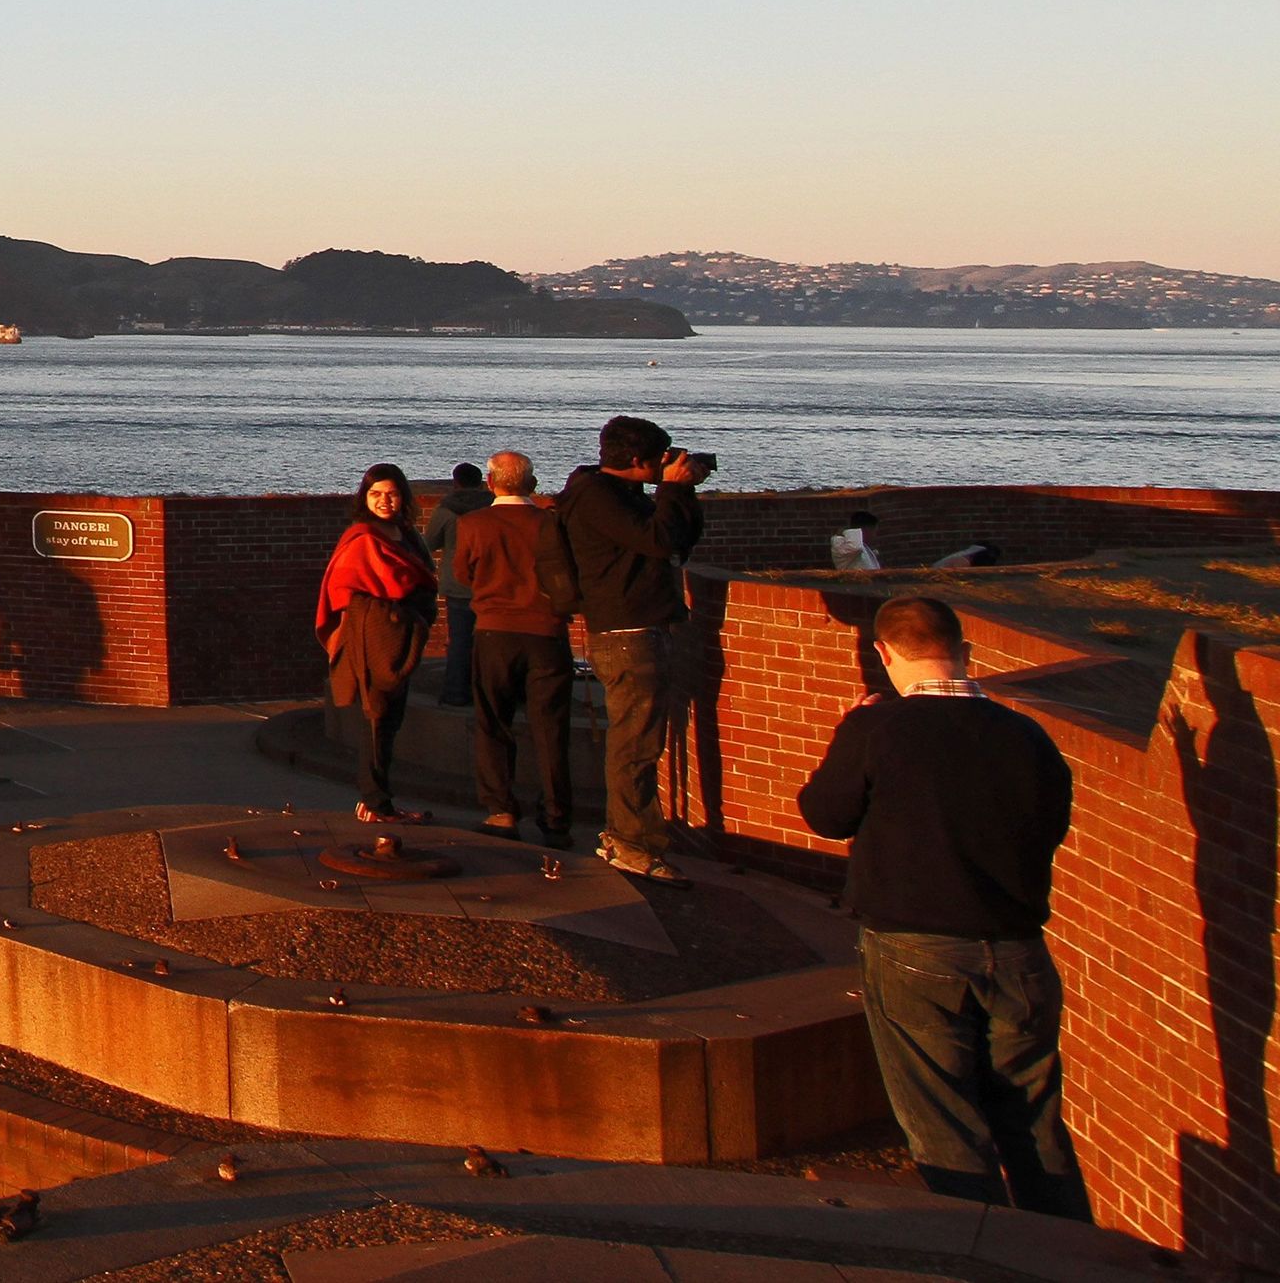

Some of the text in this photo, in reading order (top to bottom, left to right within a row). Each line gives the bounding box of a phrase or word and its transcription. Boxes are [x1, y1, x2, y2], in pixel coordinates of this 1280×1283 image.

[54, 521, 110, 532] DANGER!
[46, 536, 119, 547] stay off walls
